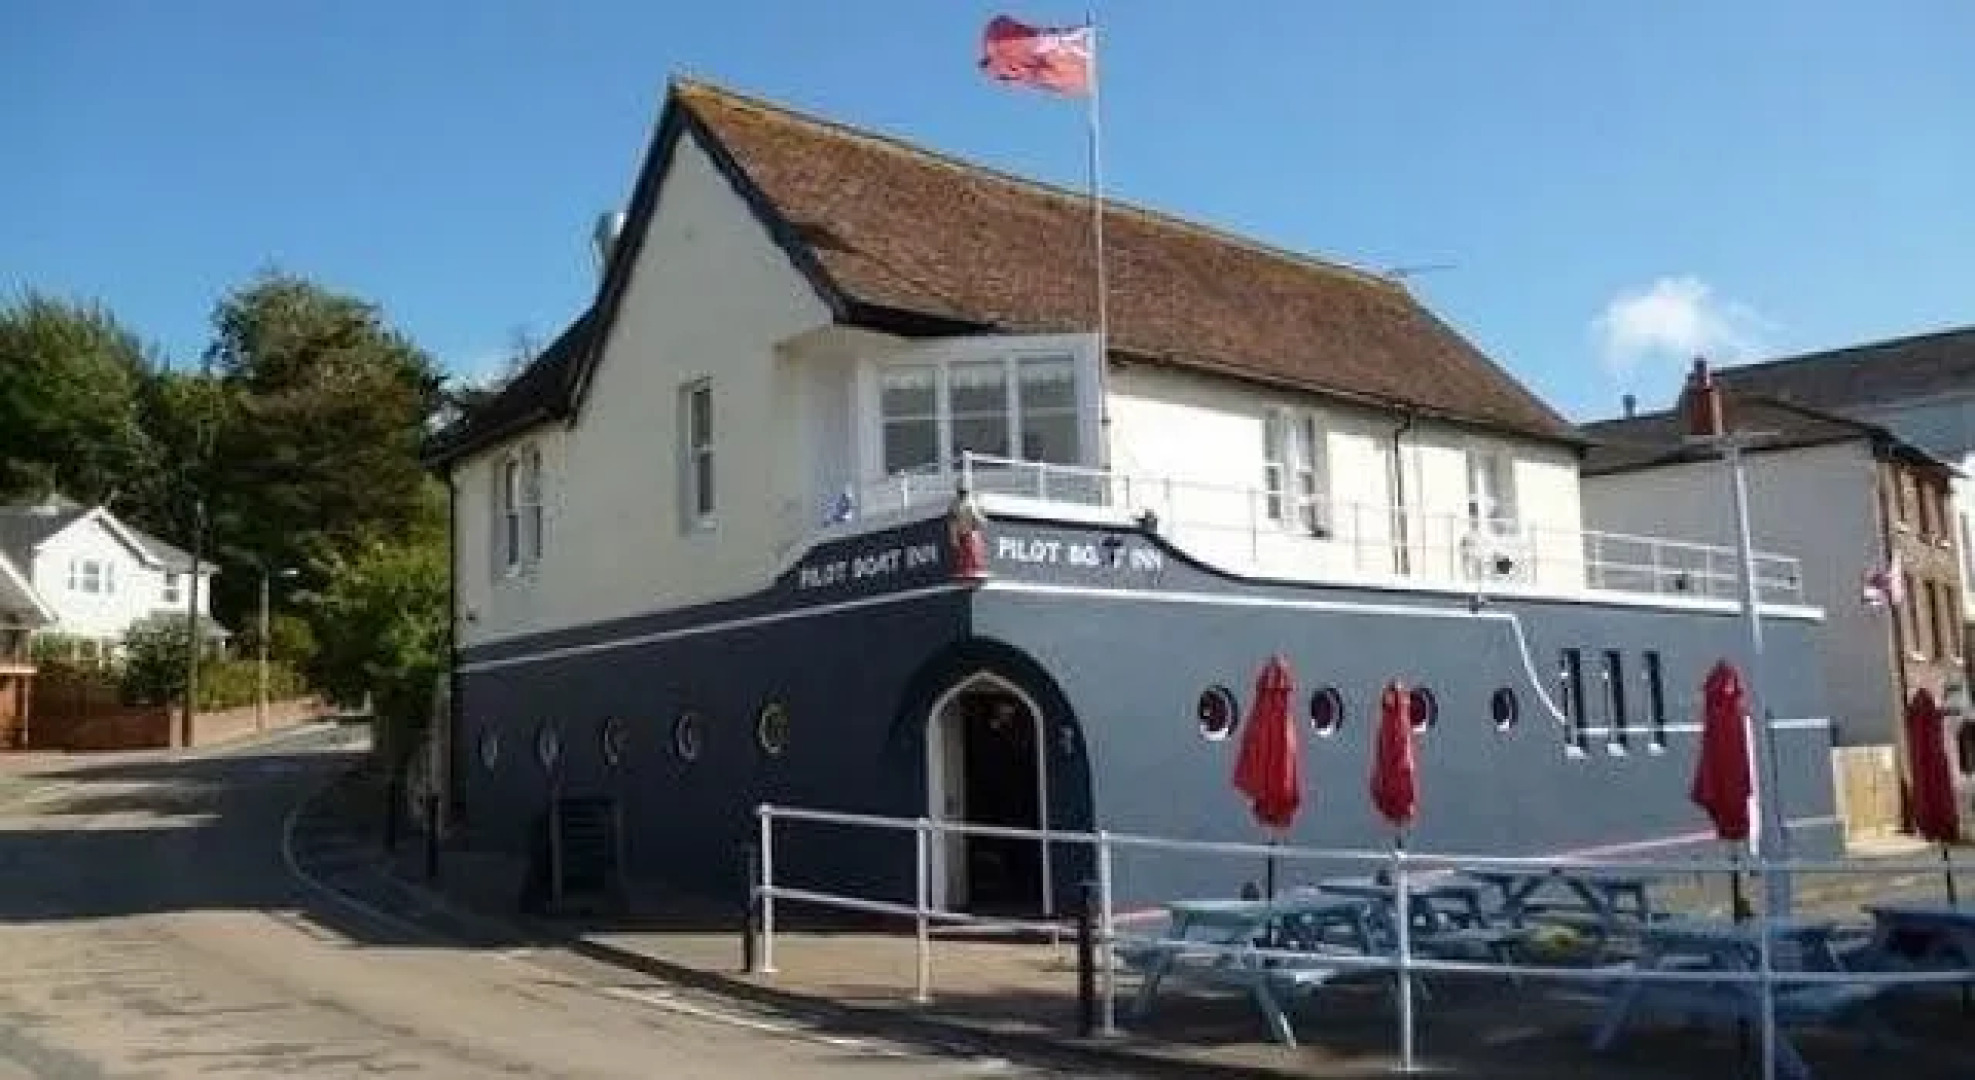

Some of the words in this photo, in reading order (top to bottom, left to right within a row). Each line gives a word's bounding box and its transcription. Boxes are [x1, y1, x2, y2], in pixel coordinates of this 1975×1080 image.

[799, 560, 847, 589] PILOT
[852, 548, 901, 578] BOAT
[998, 536, 1060, 563] PILOT
[1069, 544, 1127, 569] BOT
